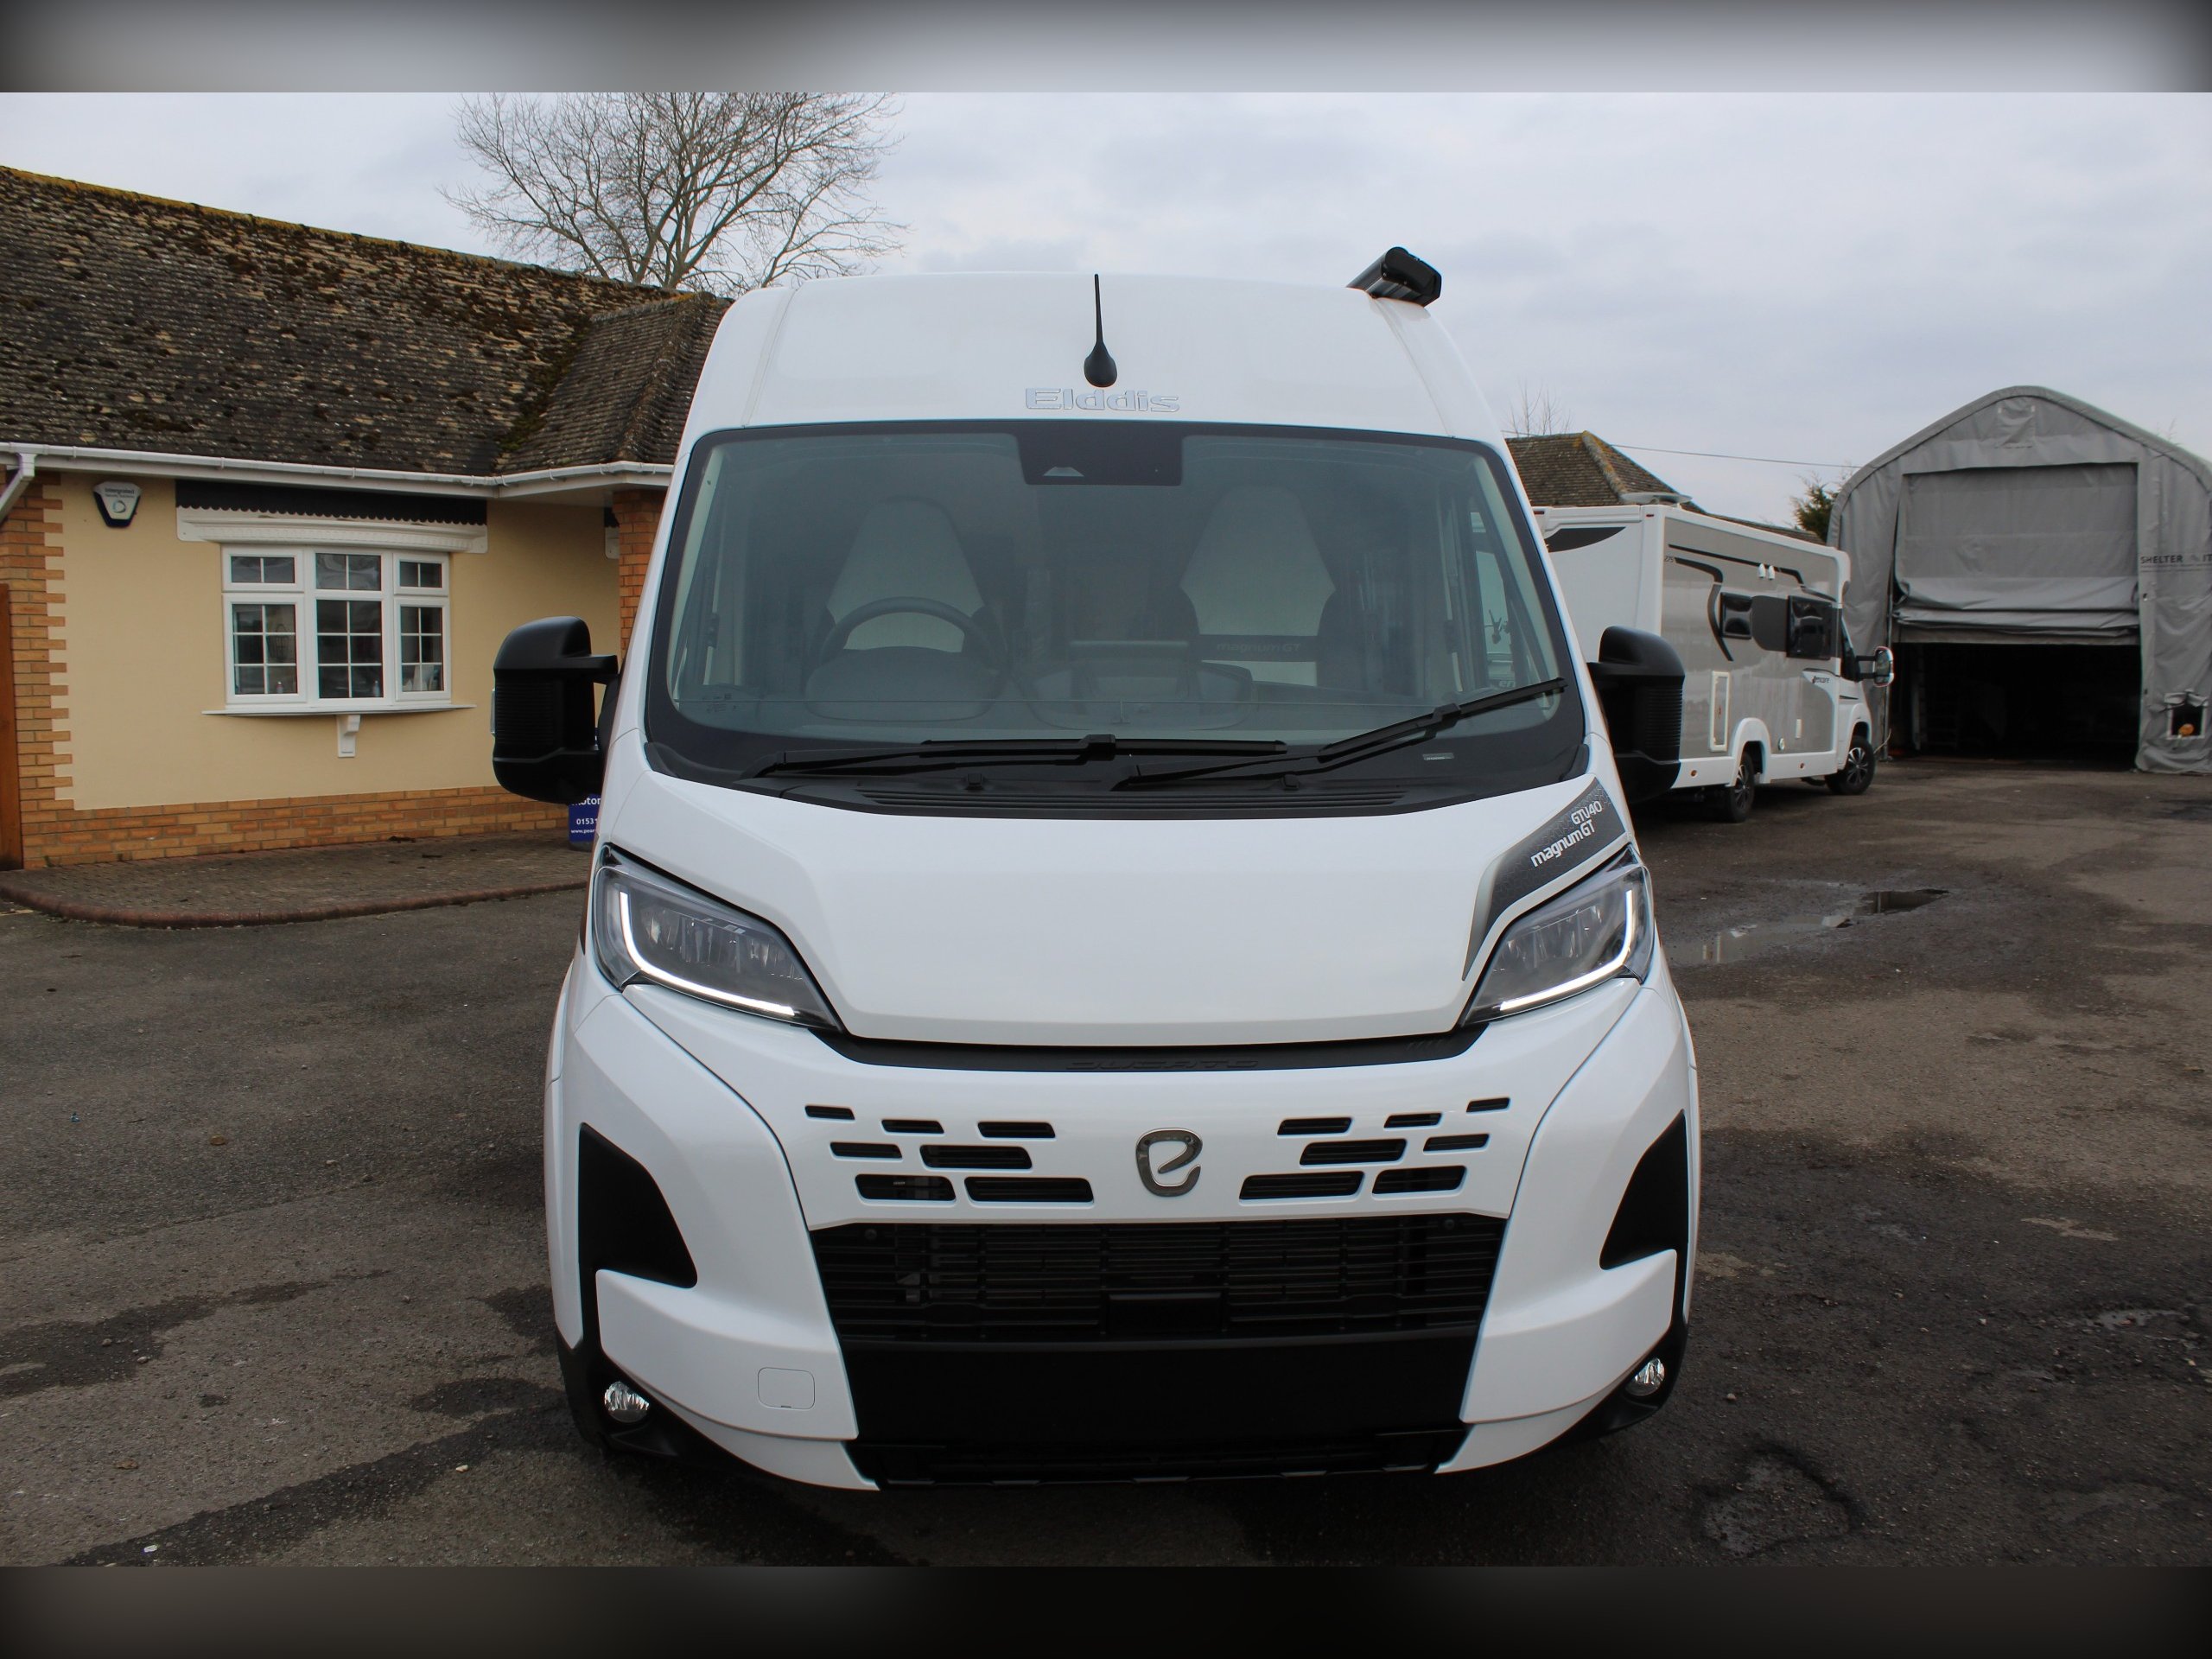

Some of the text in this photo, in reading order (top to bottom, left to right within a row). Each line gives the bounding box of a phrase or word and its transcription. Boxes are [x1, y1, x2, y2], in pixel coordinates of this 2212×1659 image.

[1025, 388, 1180, 412] Elddis
[2140, 555, 2183, 563] SHELTER
[1530, 819, 1595, 868] magnum GT
